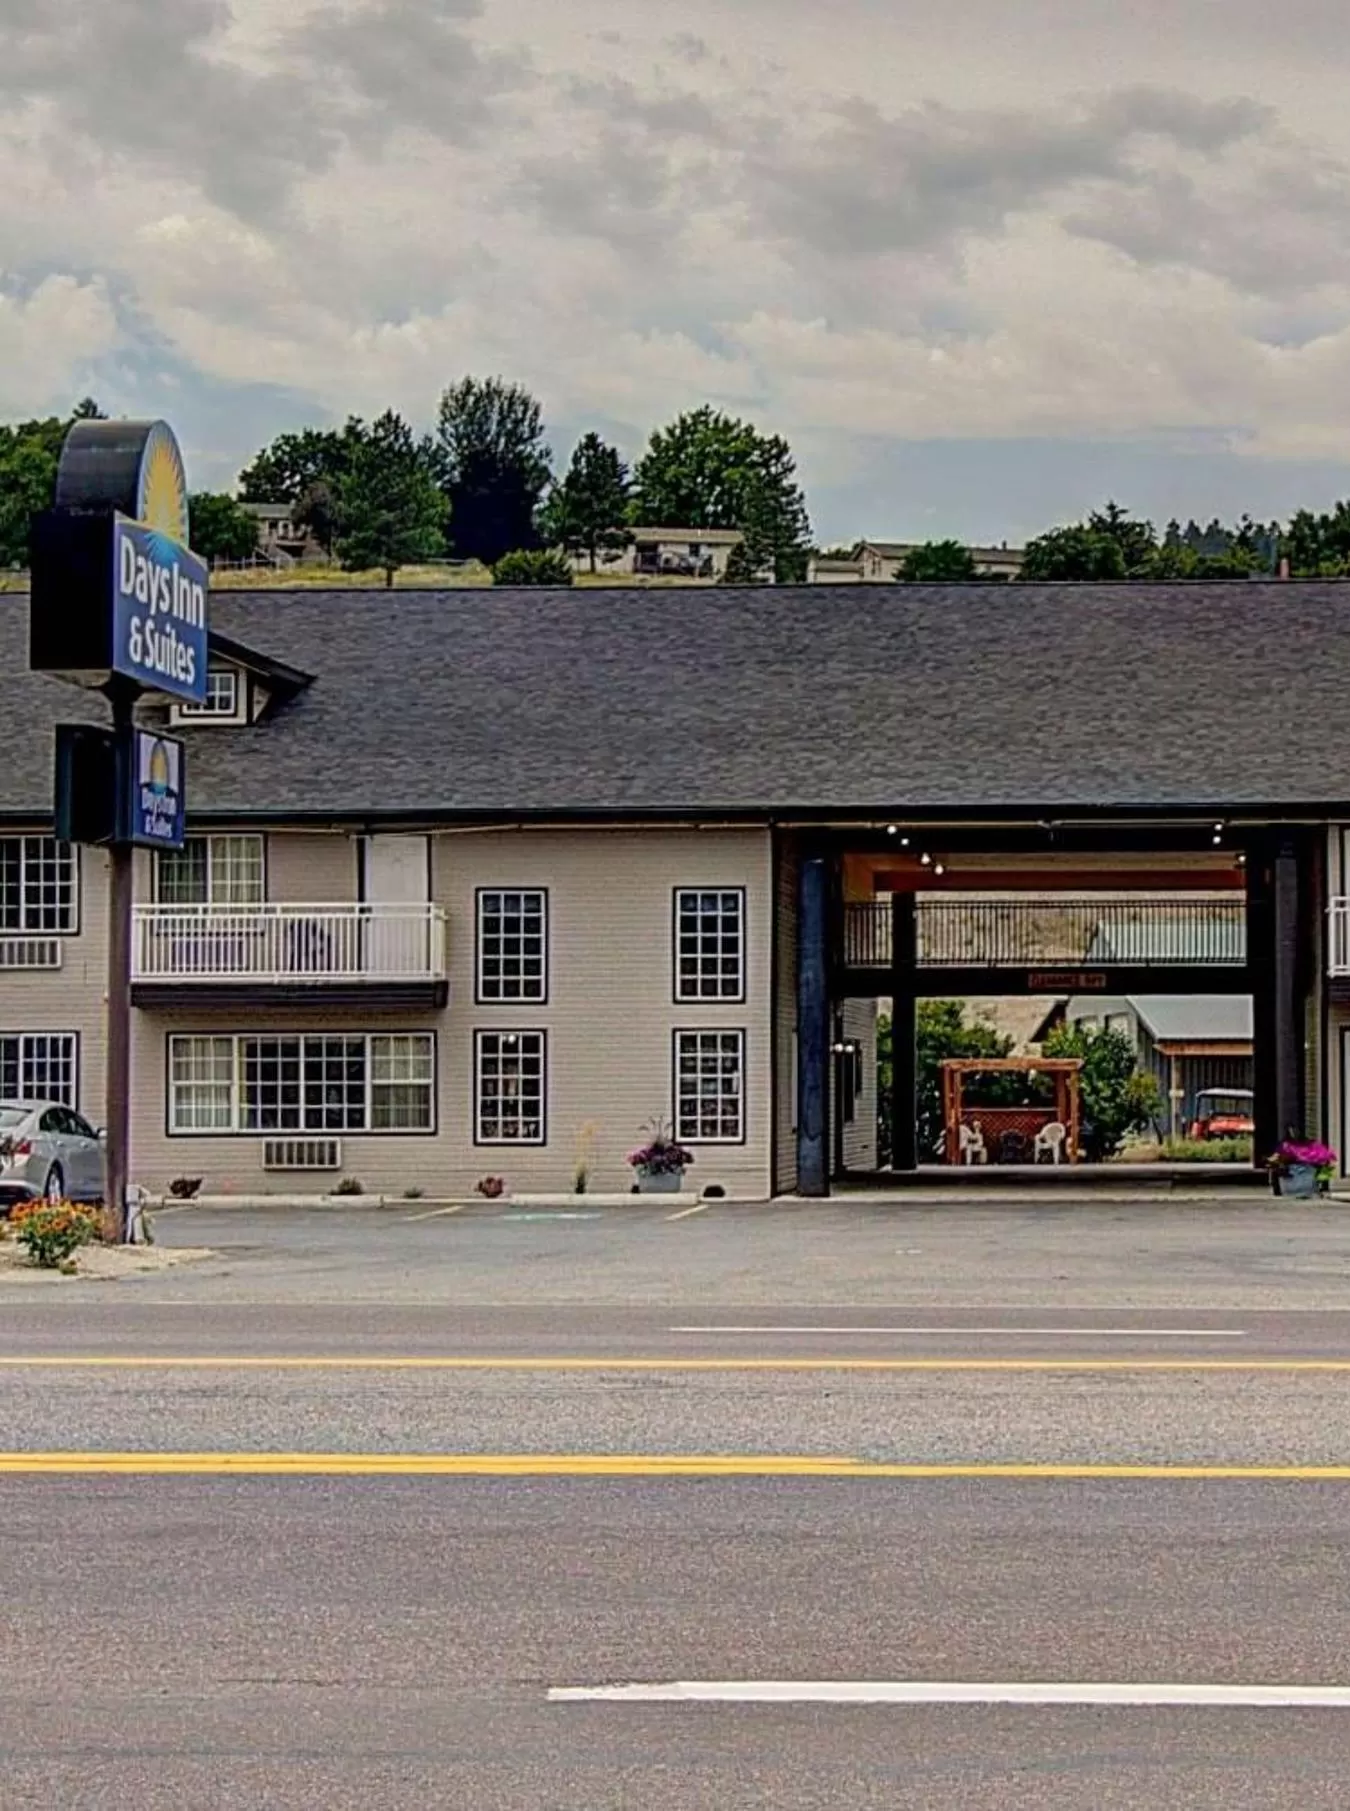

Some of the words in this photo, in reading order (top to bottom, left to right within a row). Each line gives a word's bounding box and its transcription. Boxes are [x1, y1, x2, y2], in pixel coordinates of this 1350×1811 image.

[119, 534, 170, 616] Days
[172, 561, 204, 630] Inn
[129, 616, 143, 663] &
[144, 618, 195, 685] Suites
